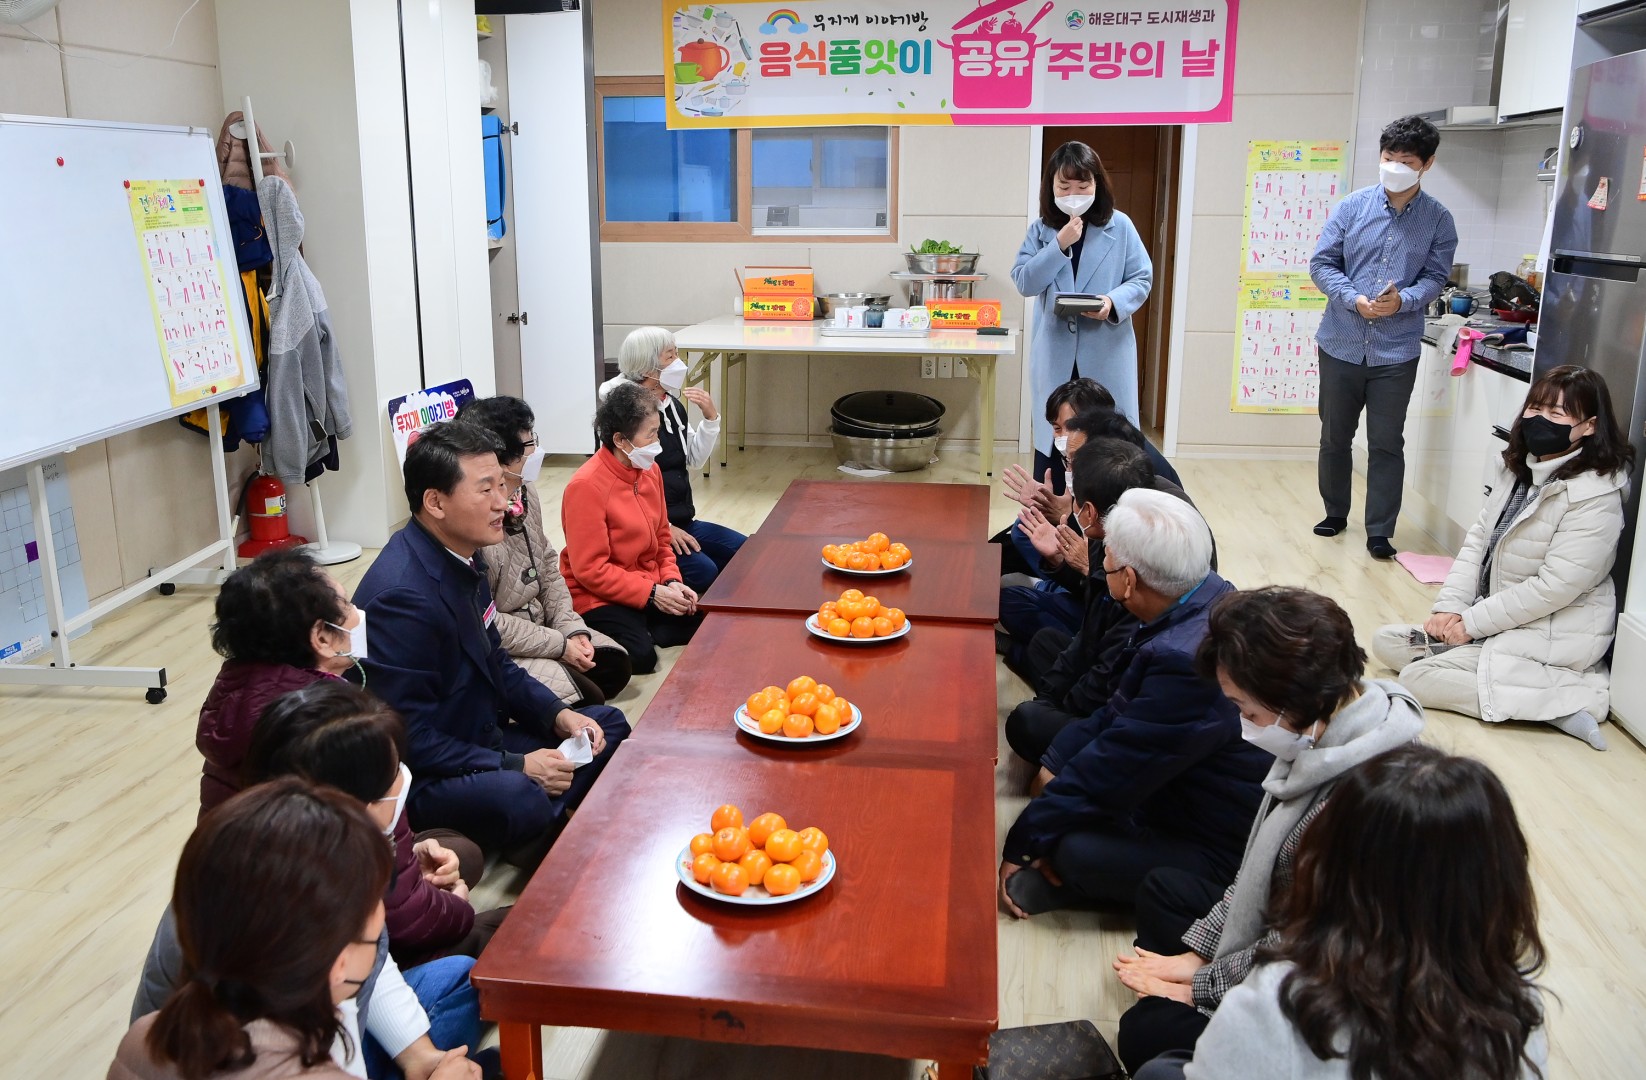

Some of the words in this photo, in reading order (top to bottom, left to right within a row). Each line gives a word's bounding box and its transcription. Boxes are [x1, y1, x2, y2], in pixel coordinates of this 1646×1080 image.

[813, 14, 859, 31] 무지개
[865, 11, 929, 32] 이야기방
[1088, 12, 1143, 26] 해운대구
[1147, 9, 1216, 25] 도시재생과
[758, 39, 932, 77] 음식품앗이
[958, 40, 1030, 77] 공유
[1047, 41, 1165, 81] 주방의
[1181, 39, 1221, 78] 날
[396, 410, 421, 434] 무지개
[420, 399, 455, 425] 이야기방
